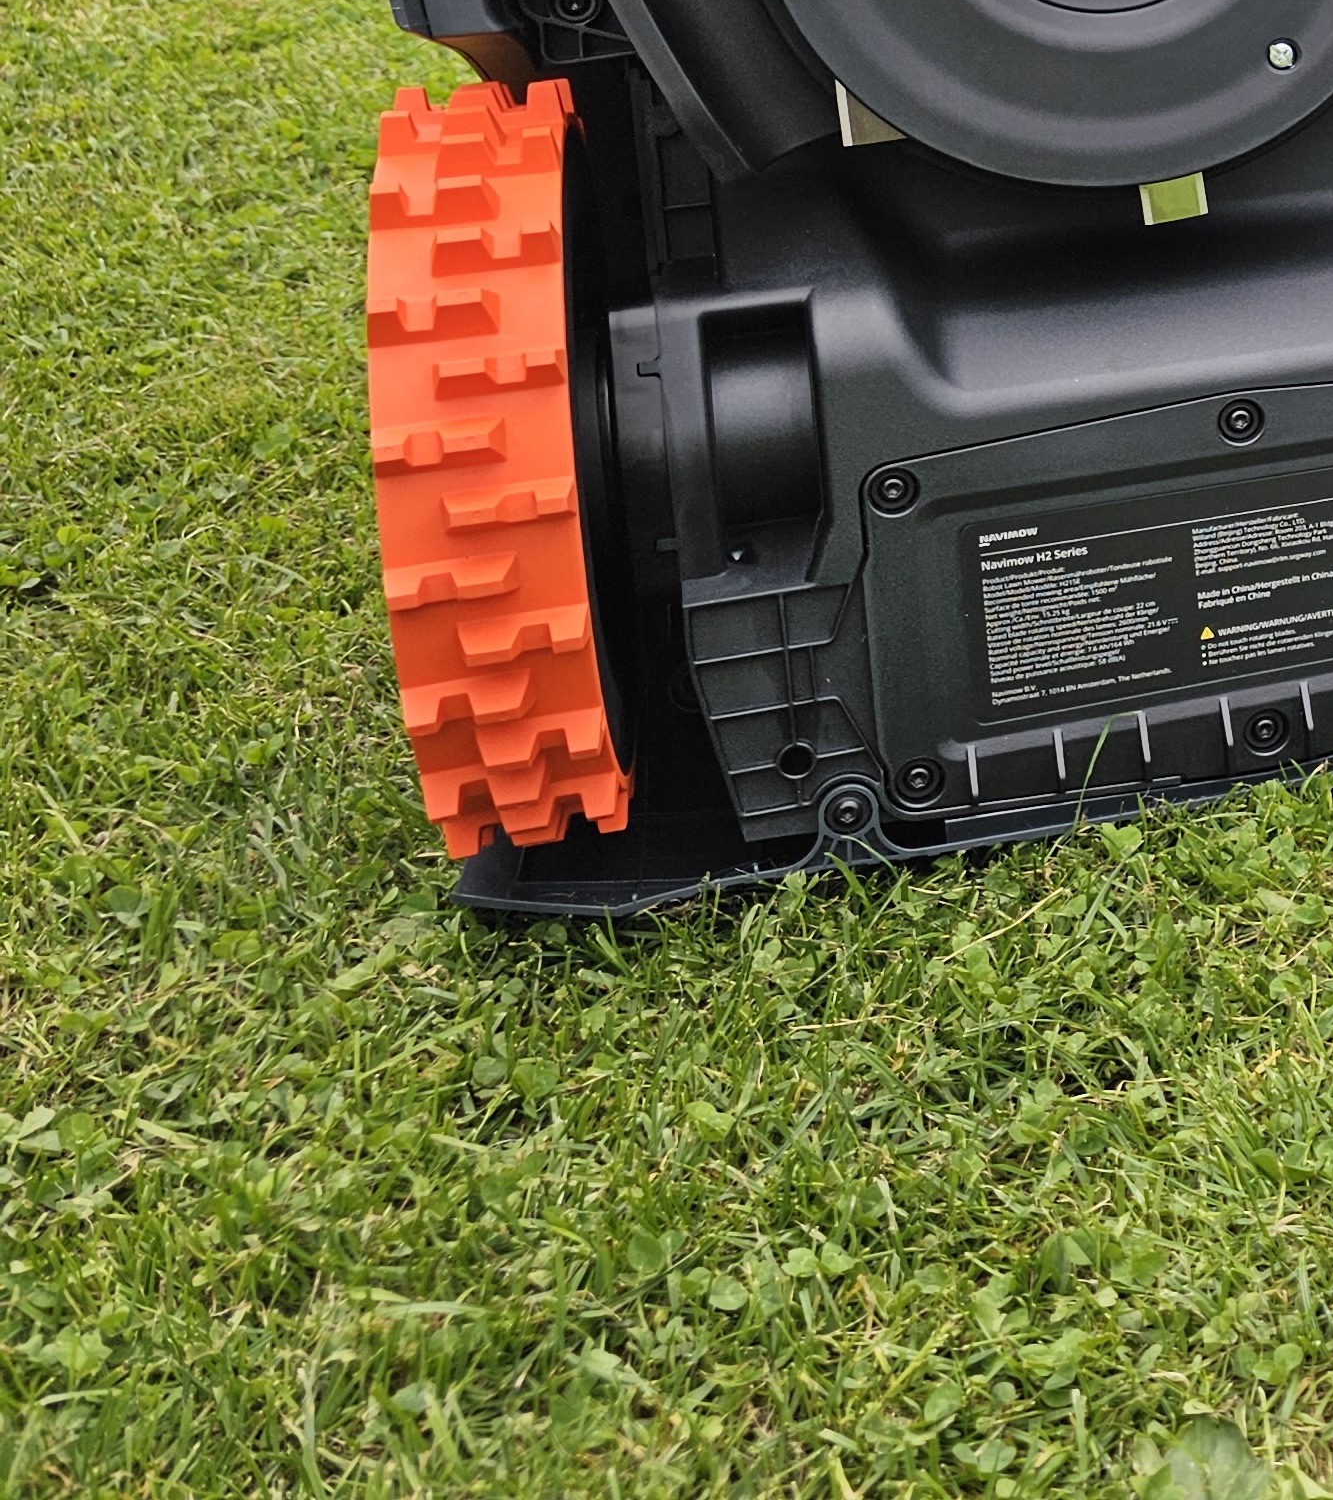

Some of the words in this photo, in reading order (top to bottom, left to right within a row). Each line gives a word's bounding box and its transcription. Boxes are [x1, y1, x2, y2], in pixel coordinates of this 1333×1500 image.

[978, 527, 1038, 545] NAVIMOW
[1243, 523, 1278, 534] Technology
[1193, 543, 1240, 556] Zhongguancun
[1241, 537, 1276, 548] Dongsheng
[1277, 531, 1312, 542] Technology
[980, 554, 1033, 571] Navimow
[1036, 551, 1052, 562] H2
[1053, 545, 1088, 559] Series
[1193, 552, 1225, 562] (Northern
[982, 584, 1003, 592] Robot
[1004, 580, 1021, 589] Lawn
[1197, 589, 1220, 600] Made
[1222, 587, 1230, 596] in
[1231, 575, 1301, 596] China/Hergestellt
[1301, 573, 1310, 582] in
[983, 593, 1034, 606] Recommended
[1035, 588, 1062, 599] mowing
[984, 604, 1010, 613] Surface
[1021, 599, 1039, 607] tonte
[1091, 587, 1107, 595] 1500
[1197, 596, 1234, 610] Fabriqué
[1235, 594, 1246, 602] en
[1247, 589, 1270, 600] Chine
[985, 613, 997, 621] Net
[1042, 610, 1060, 618] 15.25
[1061, 608, 1069, 616] kg
[986, 625, 1011, 636] Cutting
[986, 633, 1006, 642] Rated
[1008, 630, 1026, 638] blade
[1028, 625, 1054, 635] rotating
[987, 640, 1011, 649] Vitesse
[1022, 633, 1049, 642] rotation
[1051, 628, 1081, 637] nominale
[1229, 637, 1247, 645] touch
[1248, 632, 1273, 643] rotating
[1274, 628, 1296, 637] blades.
[987, 648, 1008, 656] Rated
[1208, 647, 1238, 657] Berühren
[1277, 633, 1313, 644] rotierenden
[1219, 654, 1243, 663] touchez
[1244, 651, 1256, 660] pas
[1267, 646, 1286, 654] lames
[1287, 641, 1315, 651] rotatives.
[988, 653, 1017, 663] Nominal
[1018, 648, 1046, 659] capacity
[989, 660, 1018, 671] Capacité
[1019, 654, 1050, 664] nominale
[989, 668, 1012, 677] Sound
[1012, 664, 1033, 674] power
[990, 675, 1014, 684] Niveau
[1025, 667, 1058, 679] puissance
[991, 687, 1023, 698] Navimow
[1024, 684, 1037, 692] B.V.
[991, 691, 1039, 706] Dynamostraat
[1048, 687, 1064, 695] 1014
